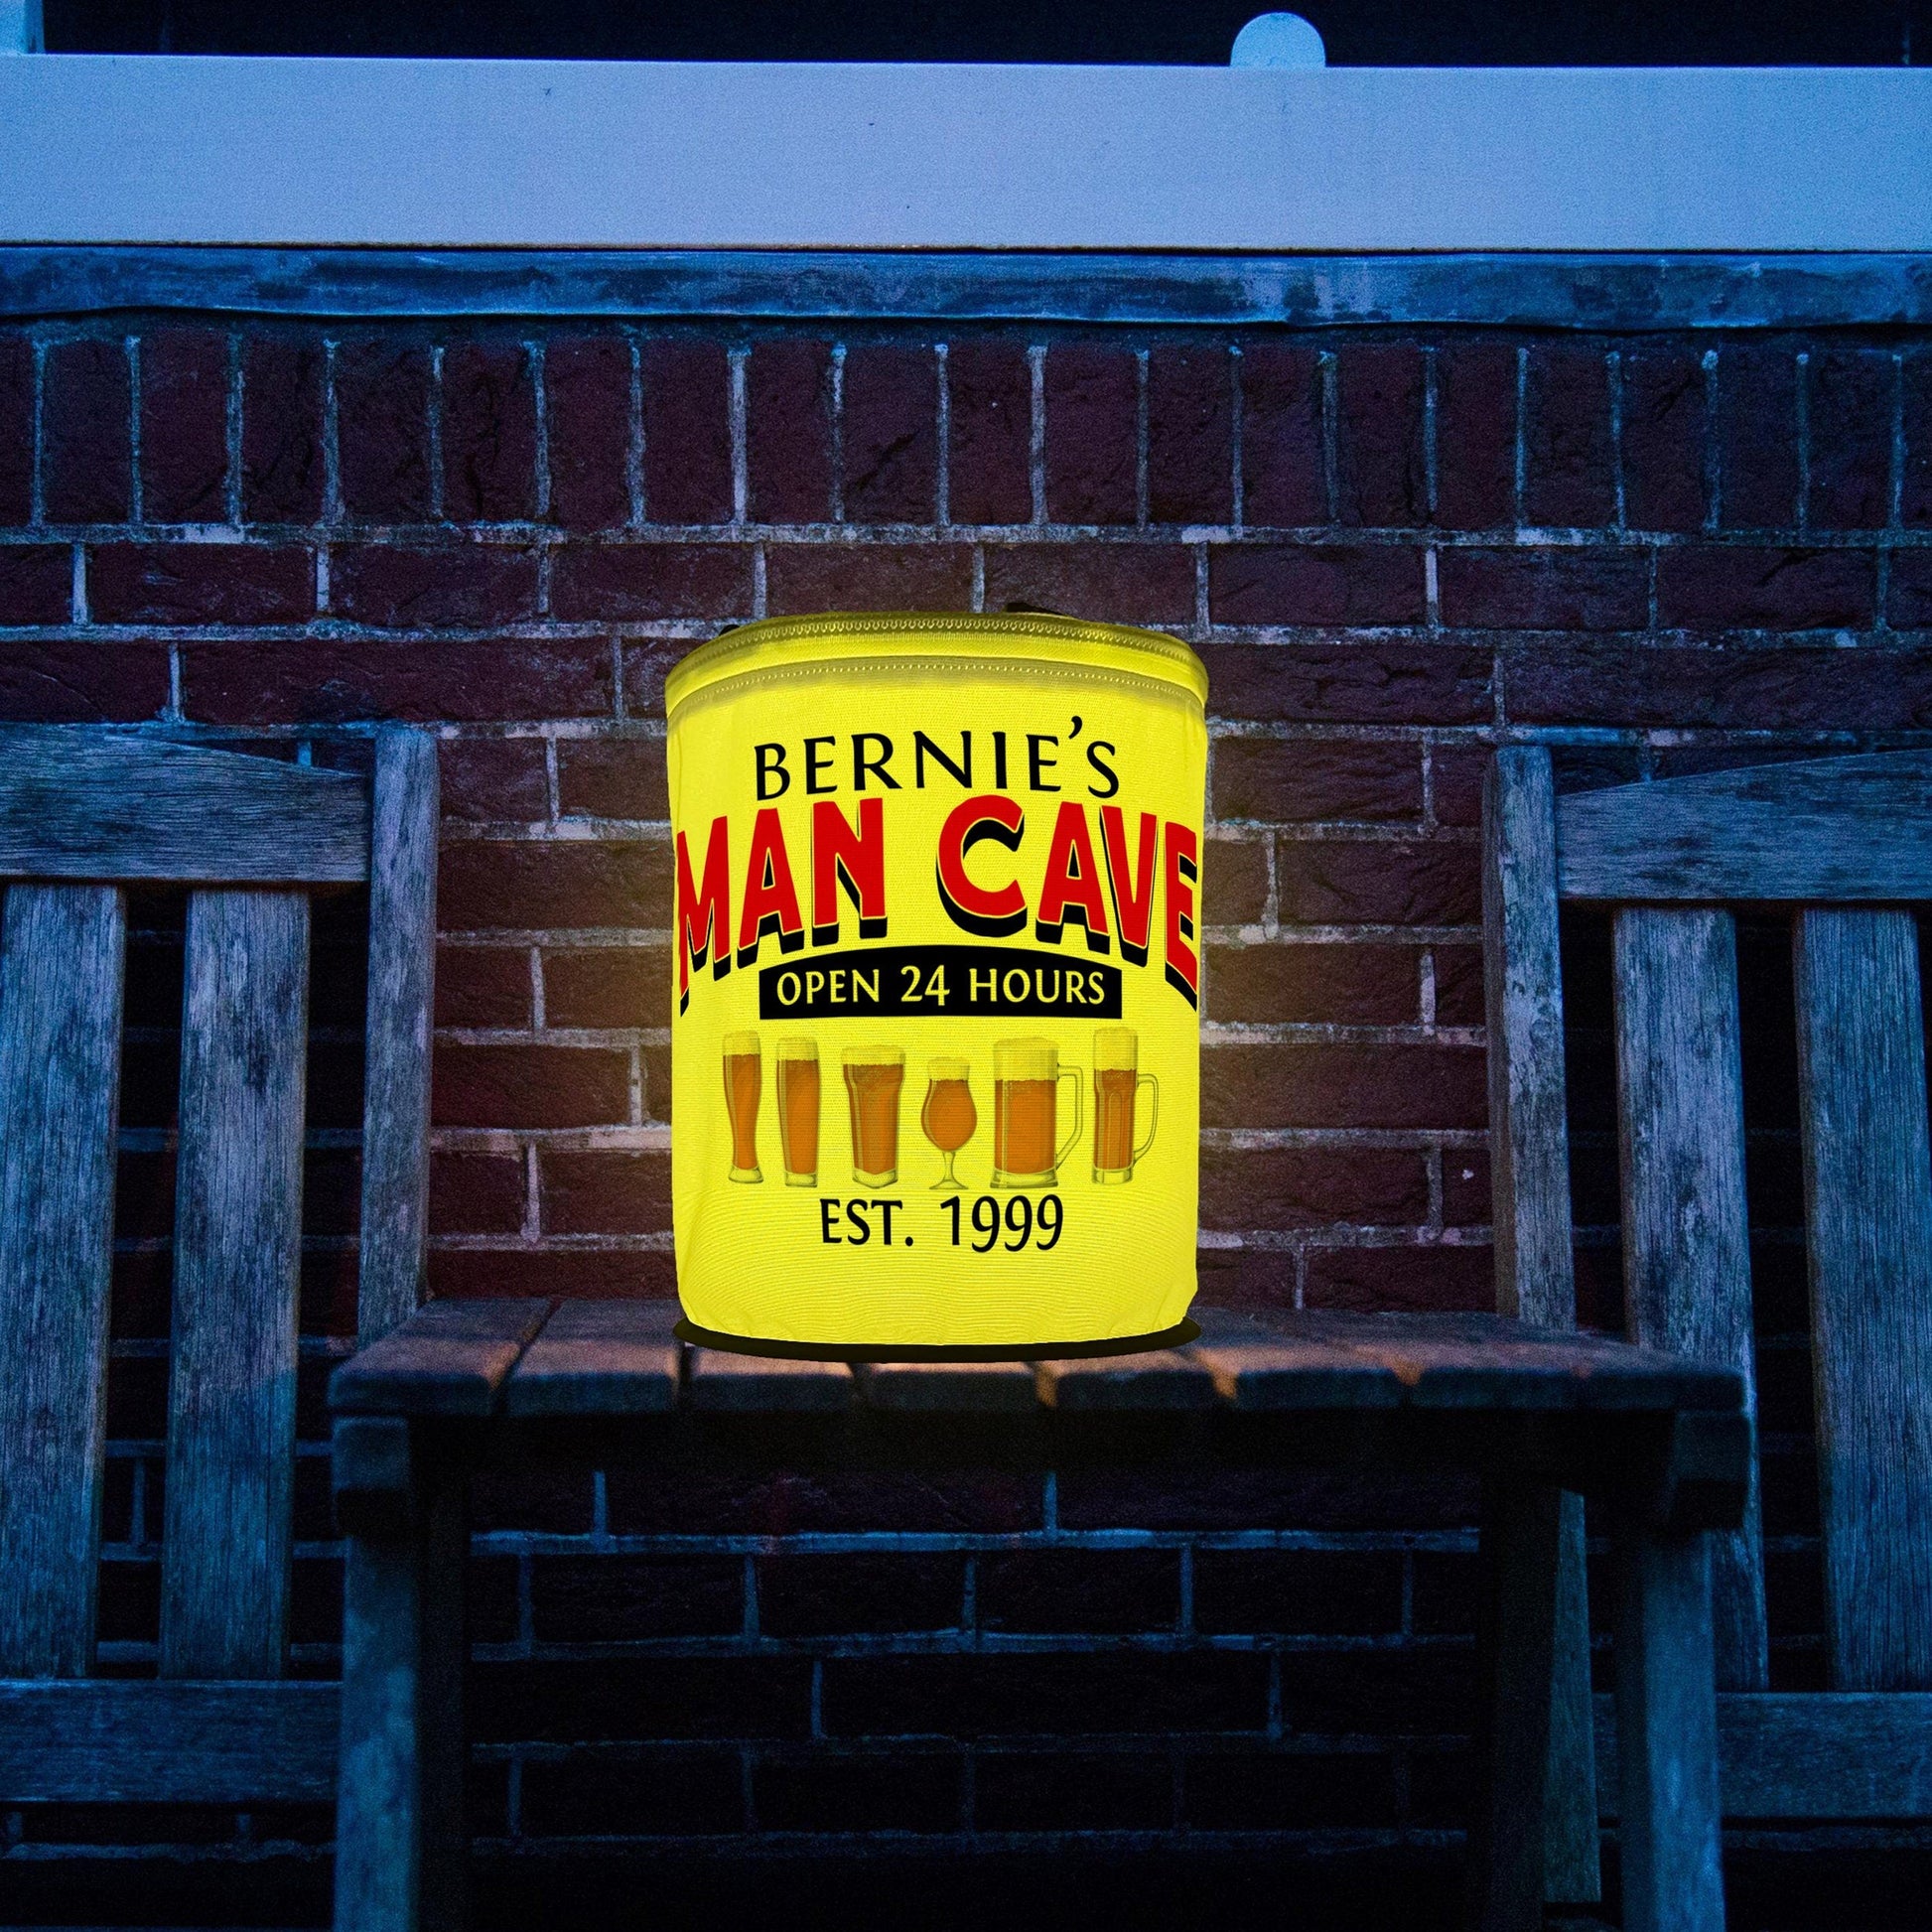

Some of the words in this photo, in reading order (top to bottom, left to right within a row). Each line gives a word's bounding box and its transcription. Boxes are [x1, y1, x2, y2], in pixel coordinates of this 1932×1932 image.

[754, 716, 1120, 800] BERNIE'S
[677, 797, 888, 1018] MAN
[935, 794, 1198, 1013] CAVE
[776, 969, 881, 1007] OPEN
[900, 964, 951, 1007] 24
[969, 967, 1106, 1006] HOURS
[819, 1198, 914, 1247] EST.
[939, 1194, 1064, 1253] 1999
